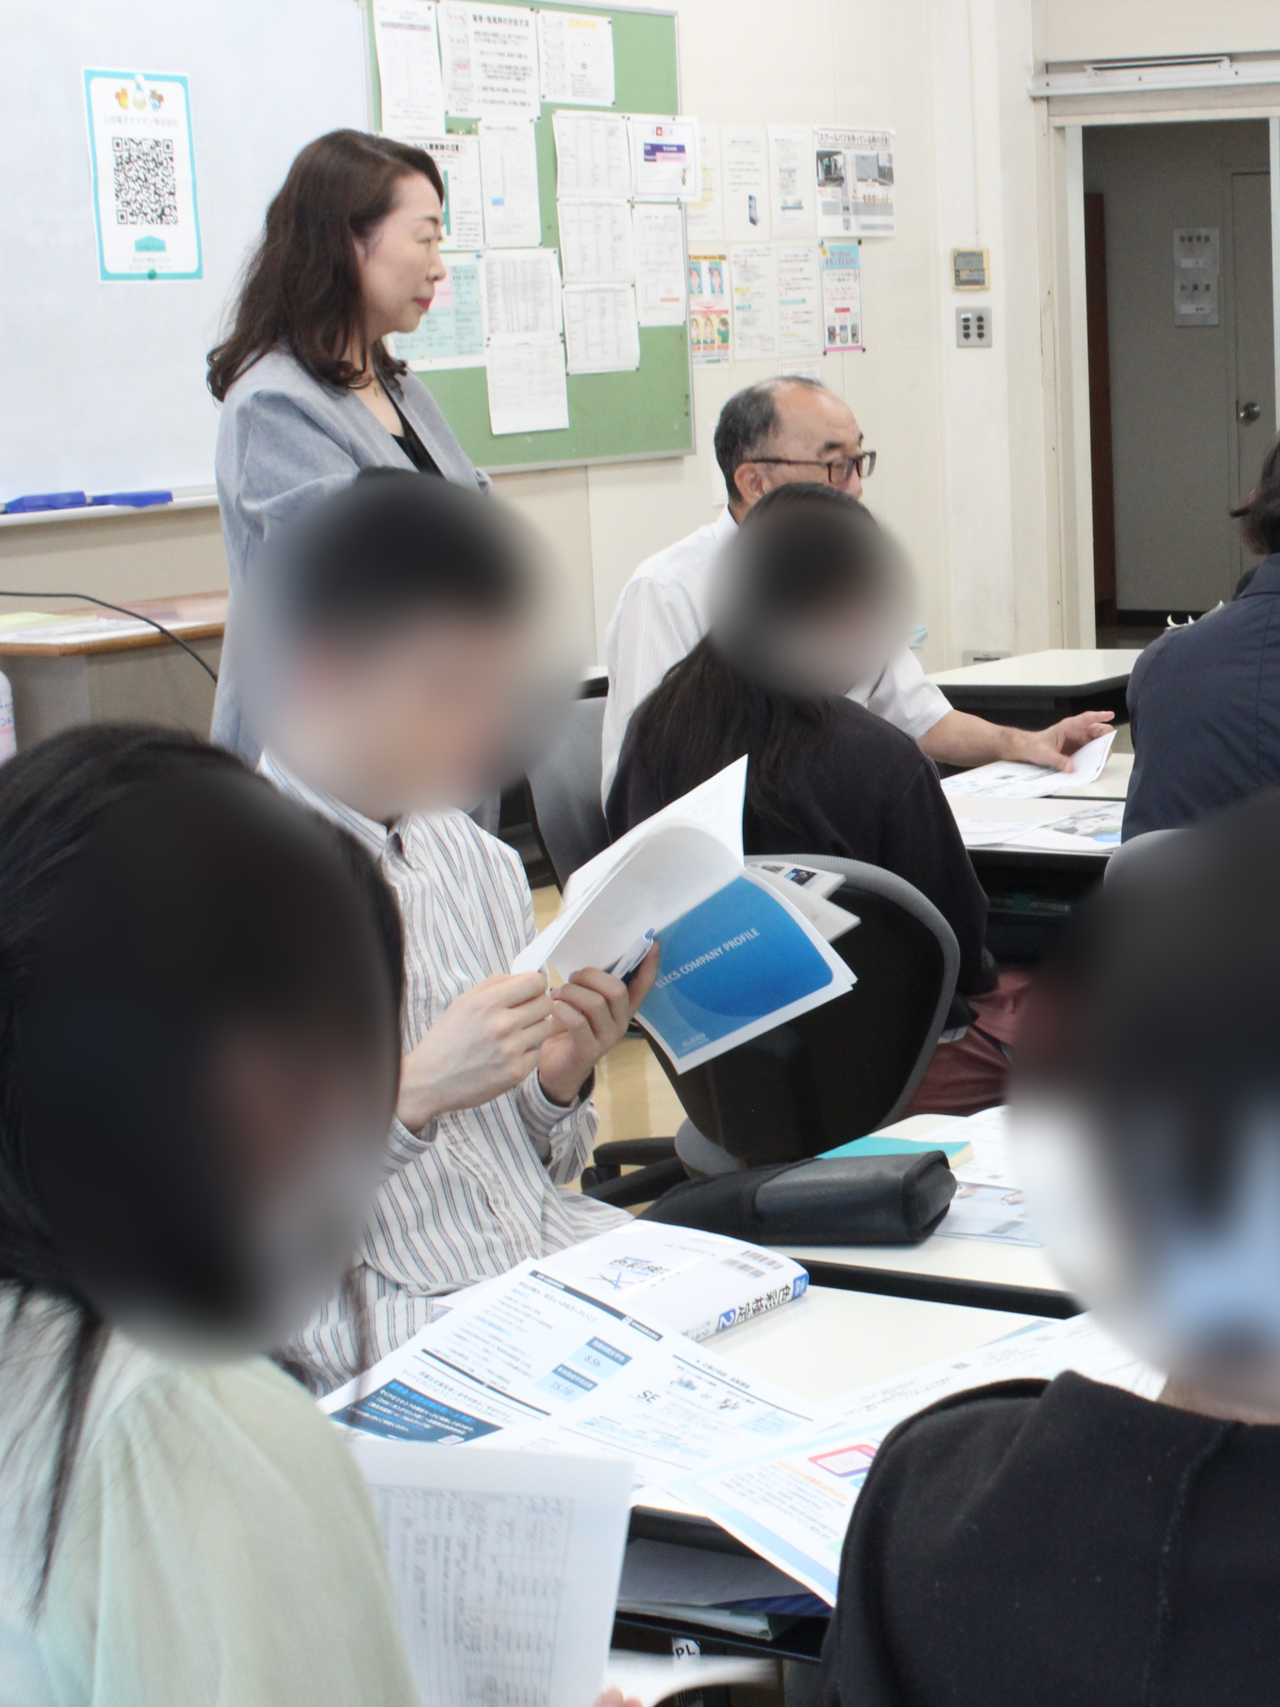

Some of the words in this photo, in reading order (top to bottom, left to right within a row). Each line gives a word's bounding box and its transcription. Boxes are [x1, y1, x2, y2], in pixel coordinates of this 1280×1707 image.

[655, 970, 682, 989] ELECS
[679, 946, 724, 976] COMPANY
[722, 927, 760, 952] PROFILE
[637, 1389, 659, 1404] SE
[675, 1644, 696, 1660] PL
